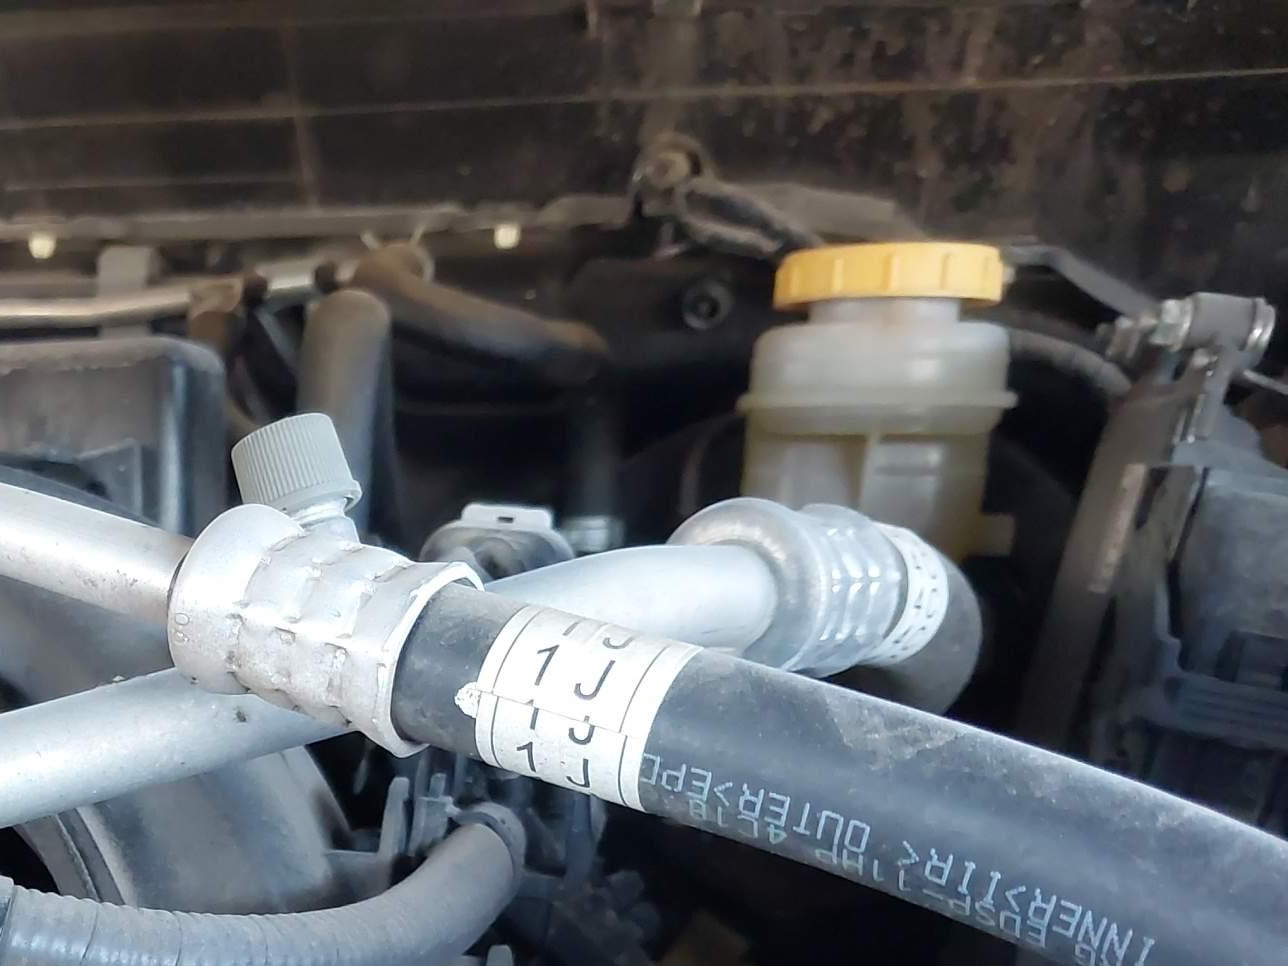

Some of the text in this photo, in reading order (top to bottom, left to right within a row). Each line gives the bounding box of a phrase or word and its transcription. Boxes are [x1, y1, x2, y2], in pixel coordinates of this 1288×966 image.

[536, 644, 616, 700] 1 J
[568, 715, 596, 745] J
[516, 741, 591, 788] 1 J
